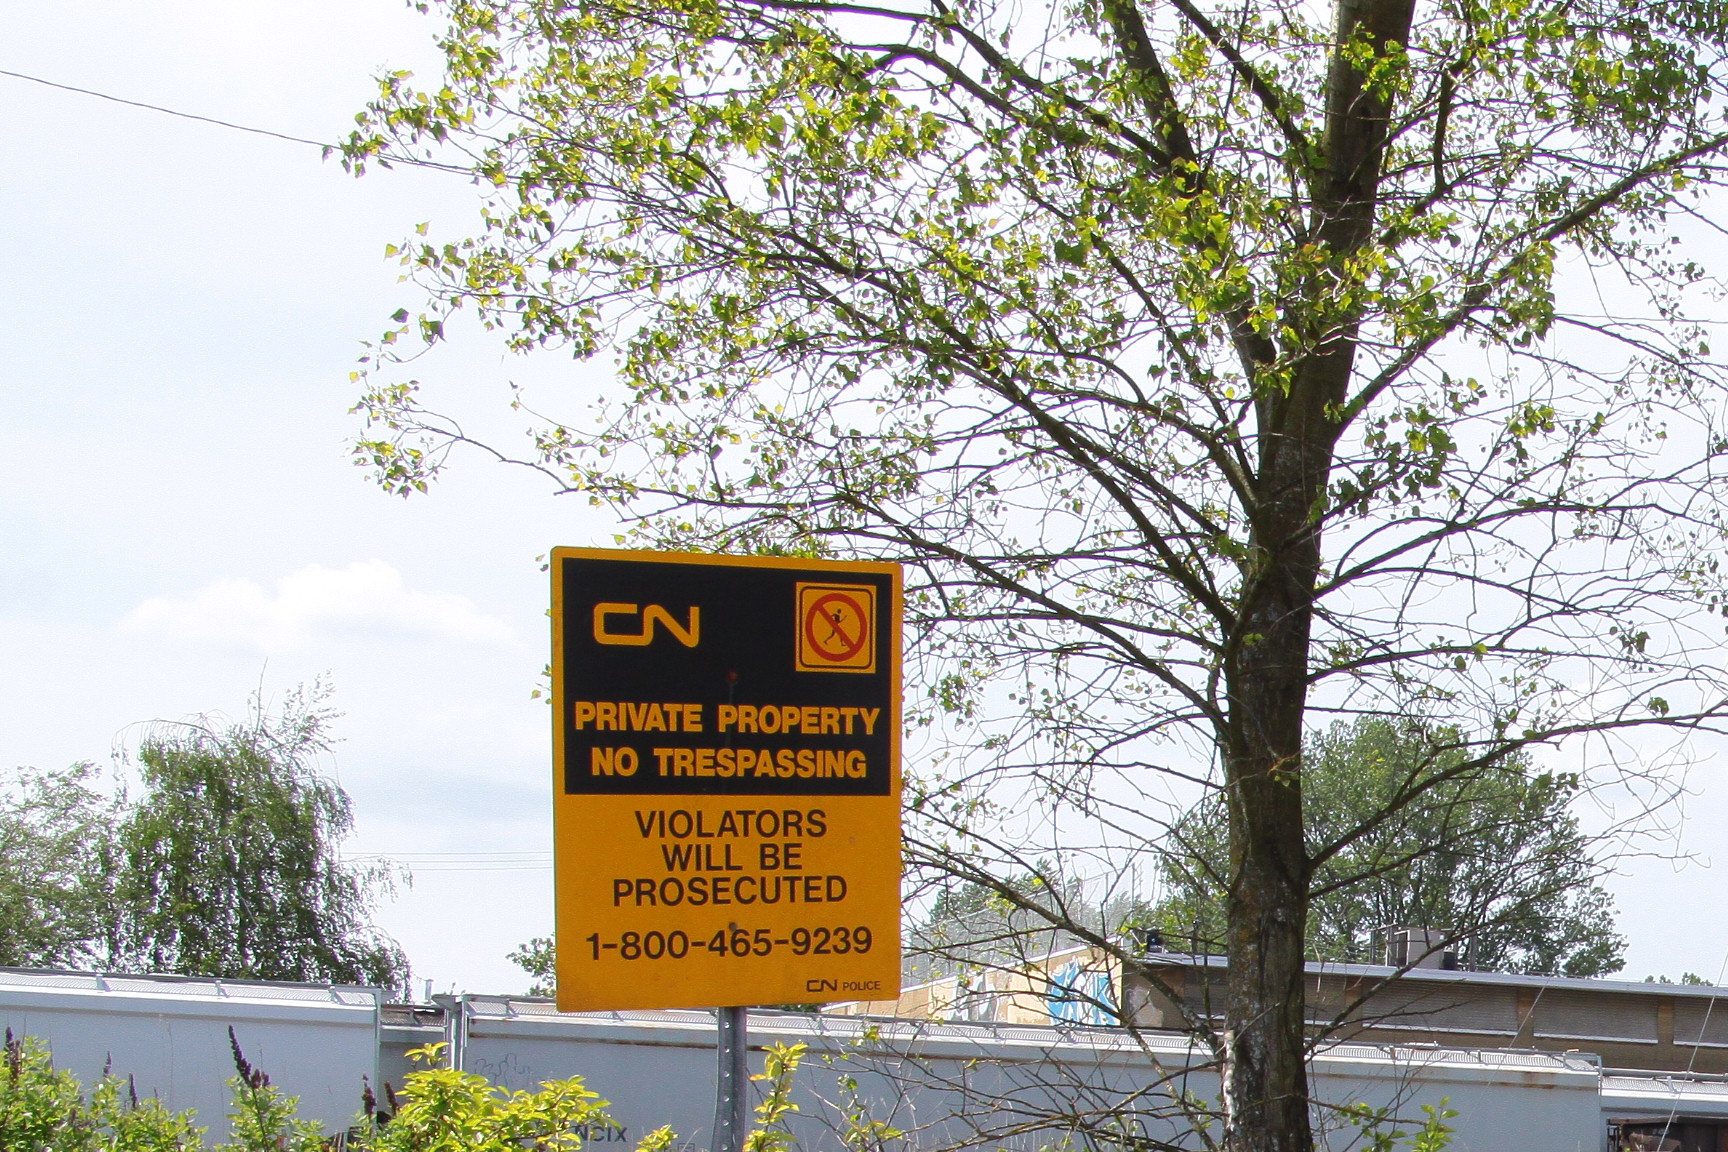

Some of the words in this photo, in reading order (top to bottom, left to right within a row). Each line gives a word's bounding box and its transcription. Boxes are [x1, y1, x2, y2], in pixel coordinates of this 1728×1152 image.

[593, 602, 700, 648] CN
[575, 701, 703, 732] PRIVATE
[718, 704, 880, 735] PROPERTY
[591, 747, 639, 777] NO
[653, 748, 868, 779] TRESPASSING
[634, 810, 828, 839] VIOLATORS
[661, 844, 742, 872] WILL
[759, 843, 803, 871] BE
[613, 875, 848, 907] PROSECUTED
[586, 926, 873, 960] 1-800-465-9239
[806, 979, 838, 992] CN
[842, 980, 881, 991] POLICE
